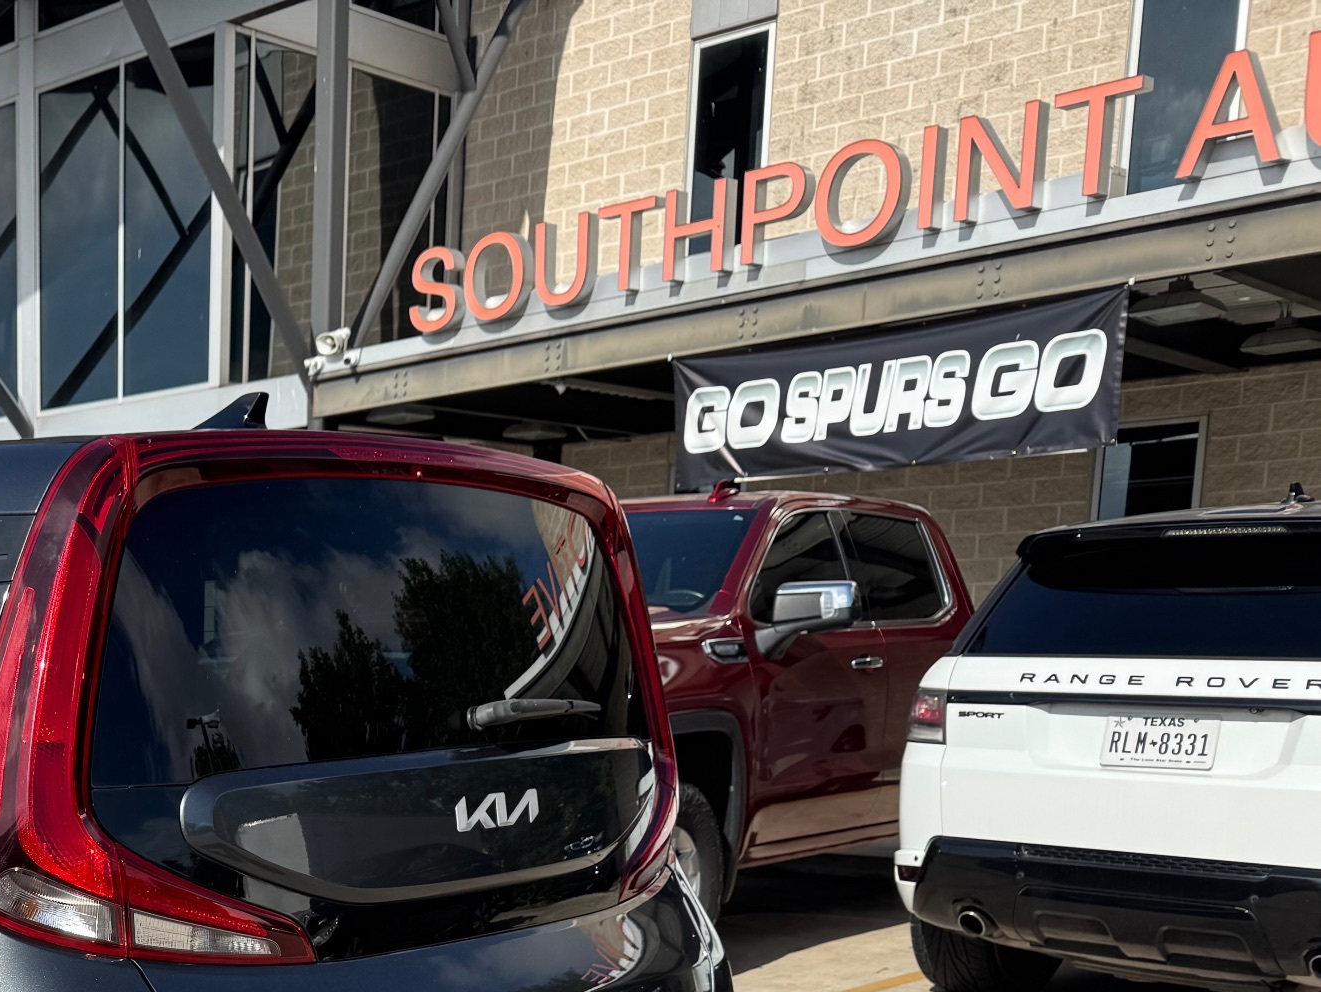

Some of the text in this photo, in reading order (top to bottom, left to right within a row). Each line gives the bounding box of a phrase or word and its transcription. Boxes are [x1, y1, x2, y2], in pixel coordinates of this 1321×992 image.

[409, 30, 1321, 333] SOUTHPOINT A
[683, 328, 1108, 454] GO SPURS GO
[1020, 673, 1321, 690] RANGE ROVER
[958, 711, 1005, 719] SPORT
[1143, 716, 1186, 728] TEXAS
[455, 788, 539, 833] KIA
